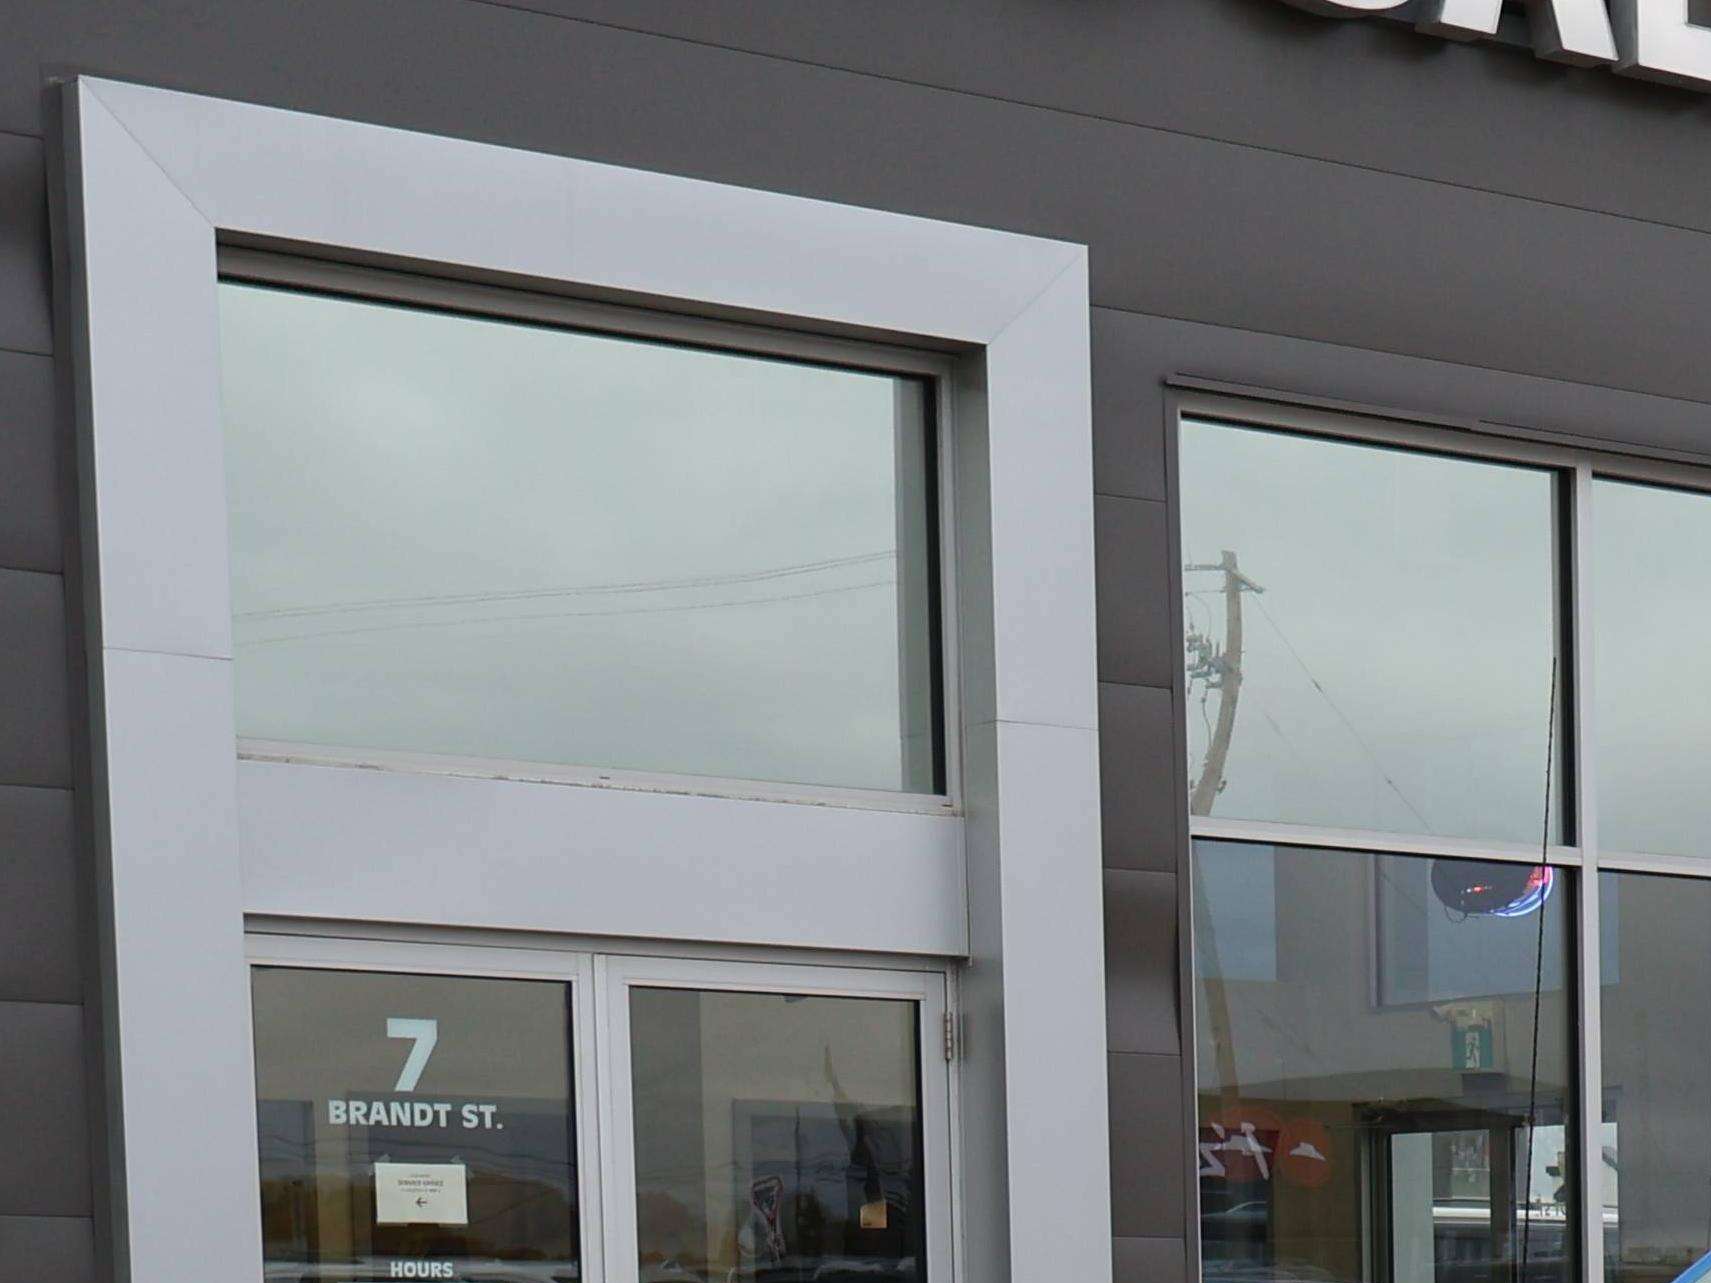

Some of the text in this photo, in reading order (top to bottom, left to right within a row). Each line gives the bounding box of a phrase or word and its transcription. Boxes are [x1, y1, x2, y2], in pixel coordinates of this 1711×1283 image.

[387, 1018, 438, 1092] 7
[328, 1100, 503, 1130] BRANDT ST.
[390, 1261, 453, 1278] HOURS
